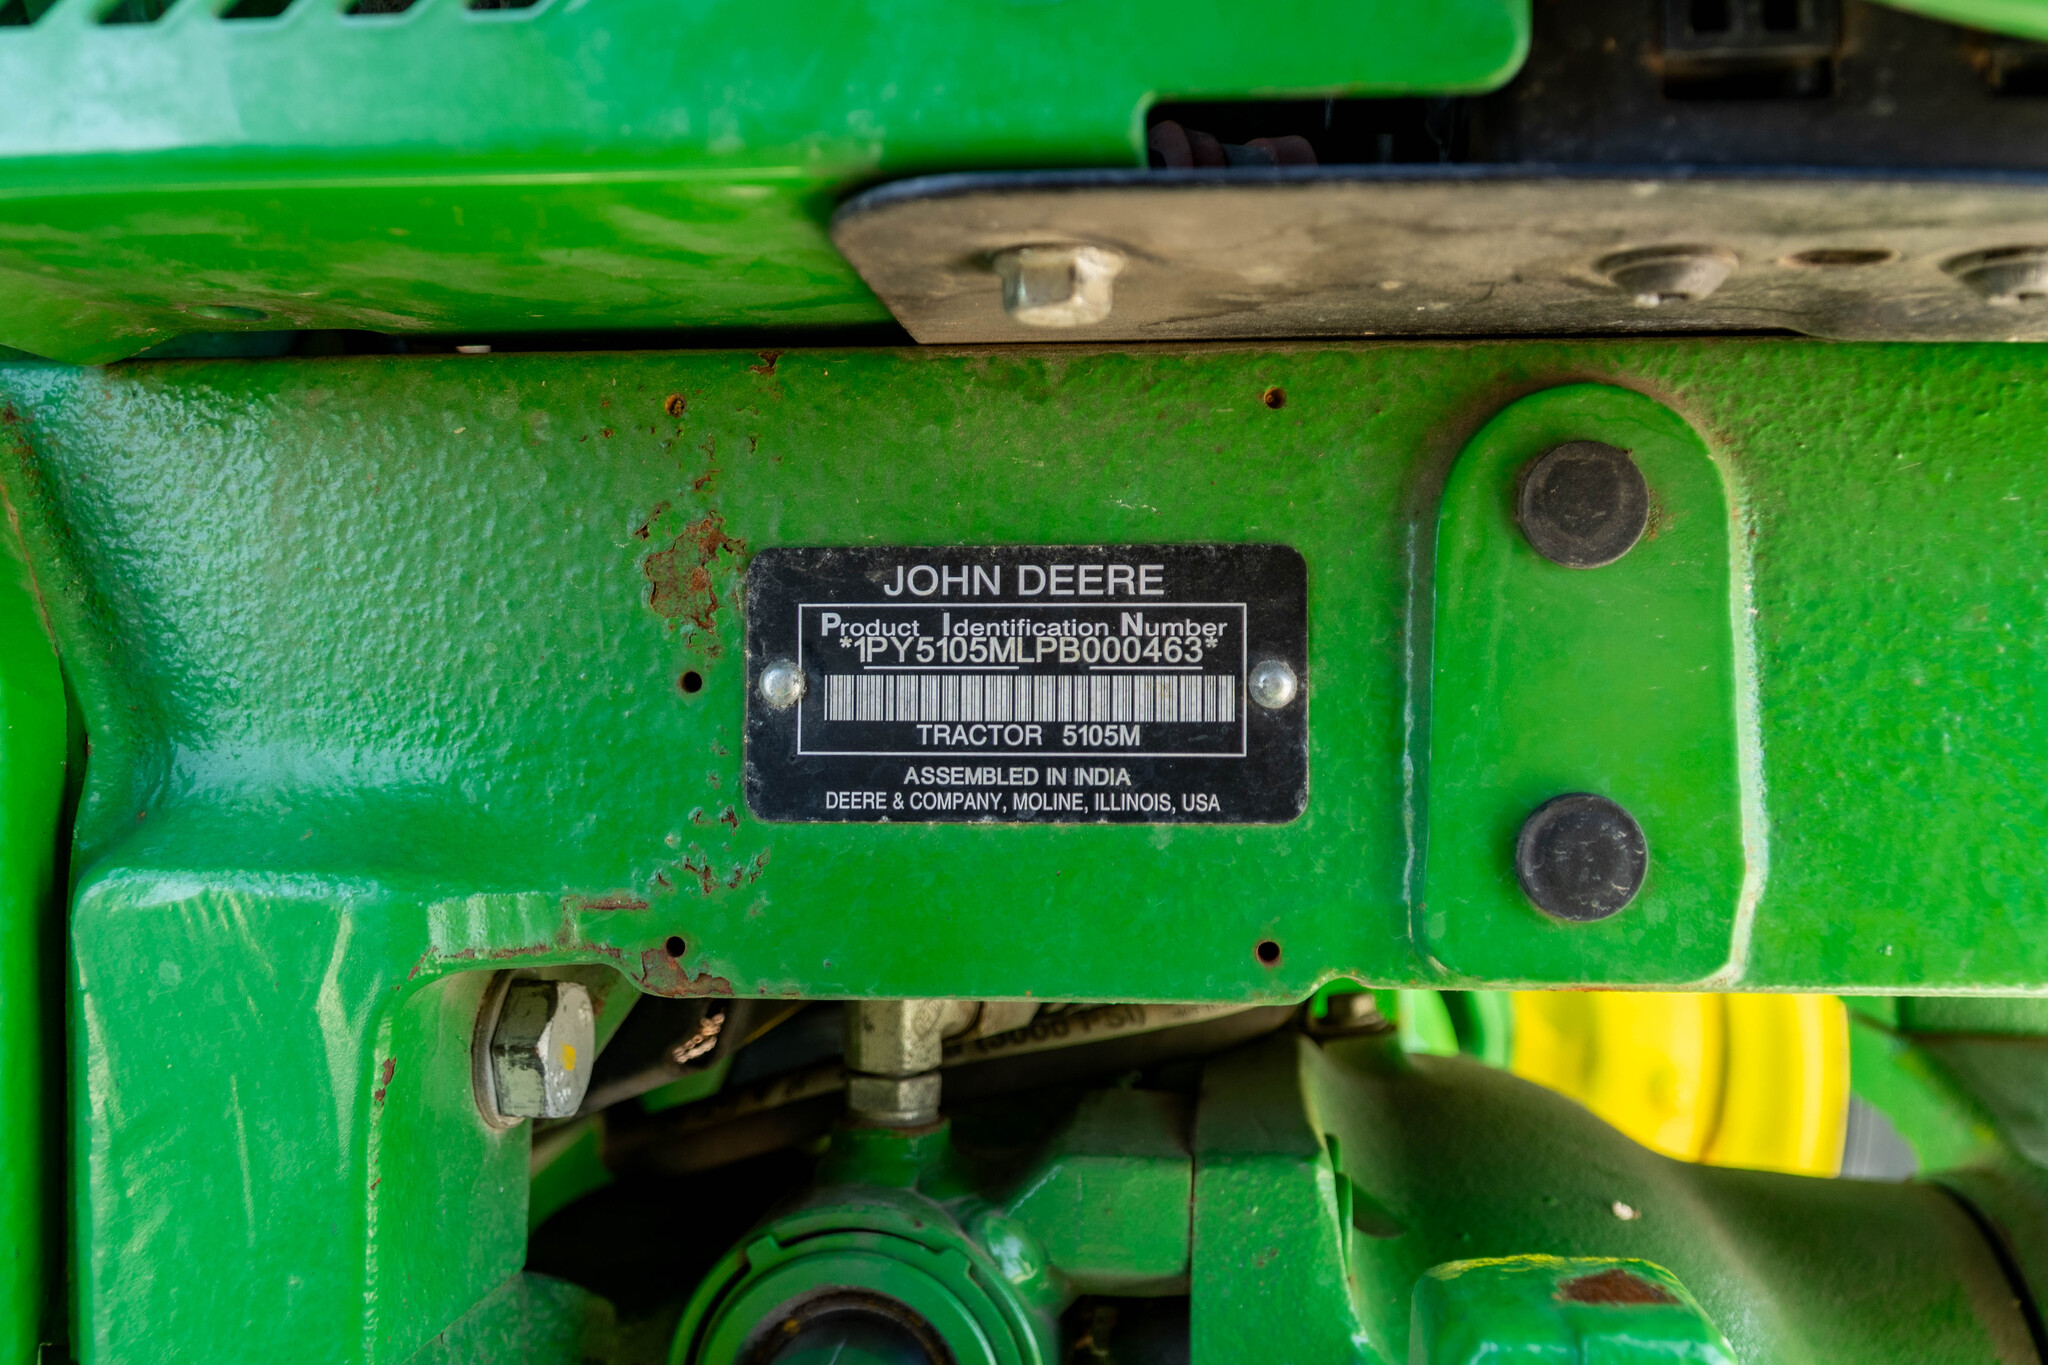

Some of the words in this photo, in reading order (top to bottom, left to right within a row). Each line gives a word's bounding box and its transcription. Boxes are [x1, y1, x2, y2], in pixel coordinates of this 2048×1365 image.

[884, 565, 1001, 597] JOHN
[1019, 565, 1165, 596] DEERE
[821, 613, 920, 637] Product
[943, 613, 1109, 637] Identification
[1121, 613, 1227, 637] Number
[917, 725, 1042, 746] TRACTOR
[1063, 726, 1140, 746] 5105M
[904, 767, 1038, 785] ASSEMBLED
[1046, 768, 1066, 785] IN
[1073, 768, 1131, 786] INDIA
[826, 792, 887, 810] DEERE
[894, 792, 904, 810] &
[909, 792, 1007, 813] COMPANY,
[1012, 793, 1089, 814] MOLINE,
[1094, 794, 1176, 814] ILLINOIS,
[1182, 795, 1220, 812] USA
